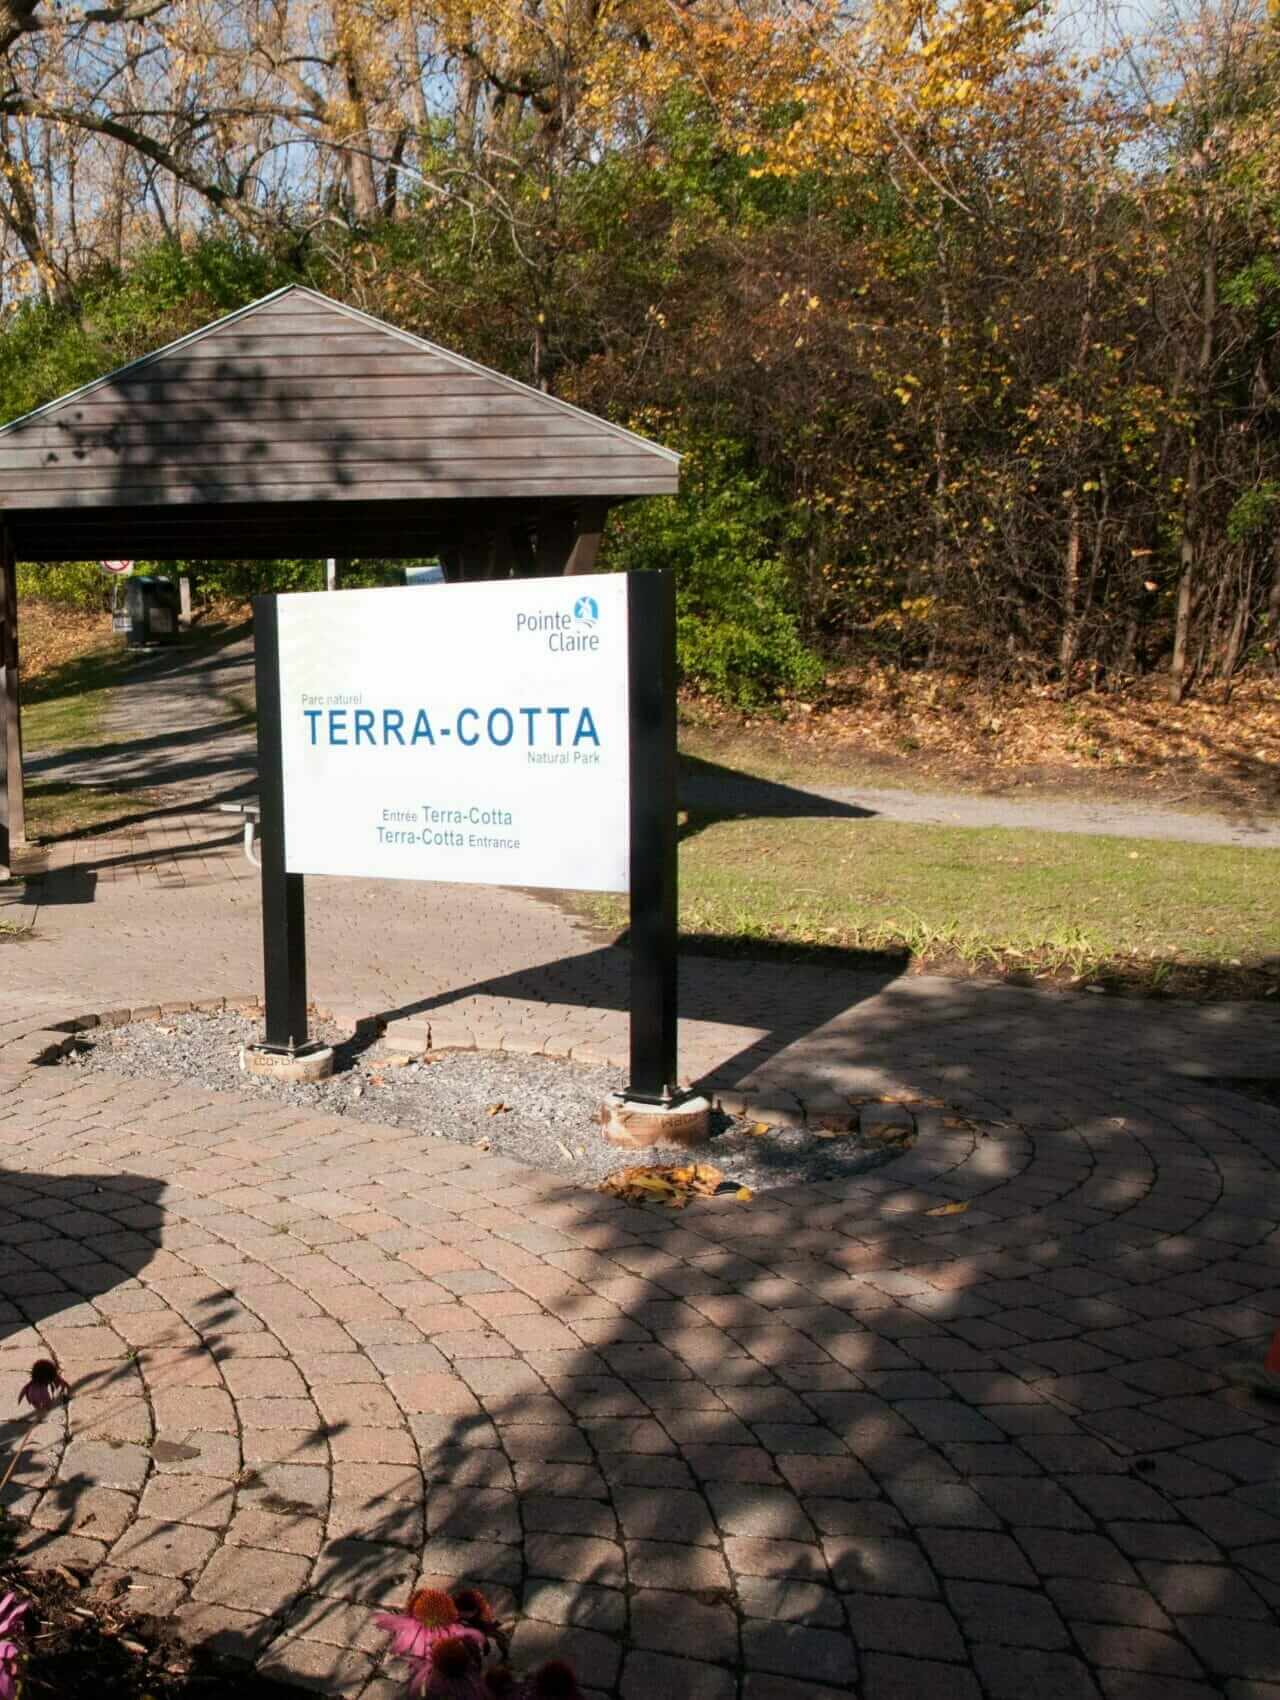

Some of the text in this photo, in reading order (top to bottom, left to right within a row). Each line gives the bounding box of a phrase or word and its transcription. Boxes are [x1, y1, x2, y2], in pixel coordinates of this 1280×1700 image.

[516, 610, 572, 633] Pointe
[548, 632, 600, 652] Claire
[301, 694, 362, 705] Parc naturel
[303, 707, 601, 746] TERRA-COTTA
[527, 751, 600, 764] Natural Park
[382, 806, 513, 825] Entrée Terra-Cotta
[377, 826, 521, 849] Terra-Cotta Entrance
